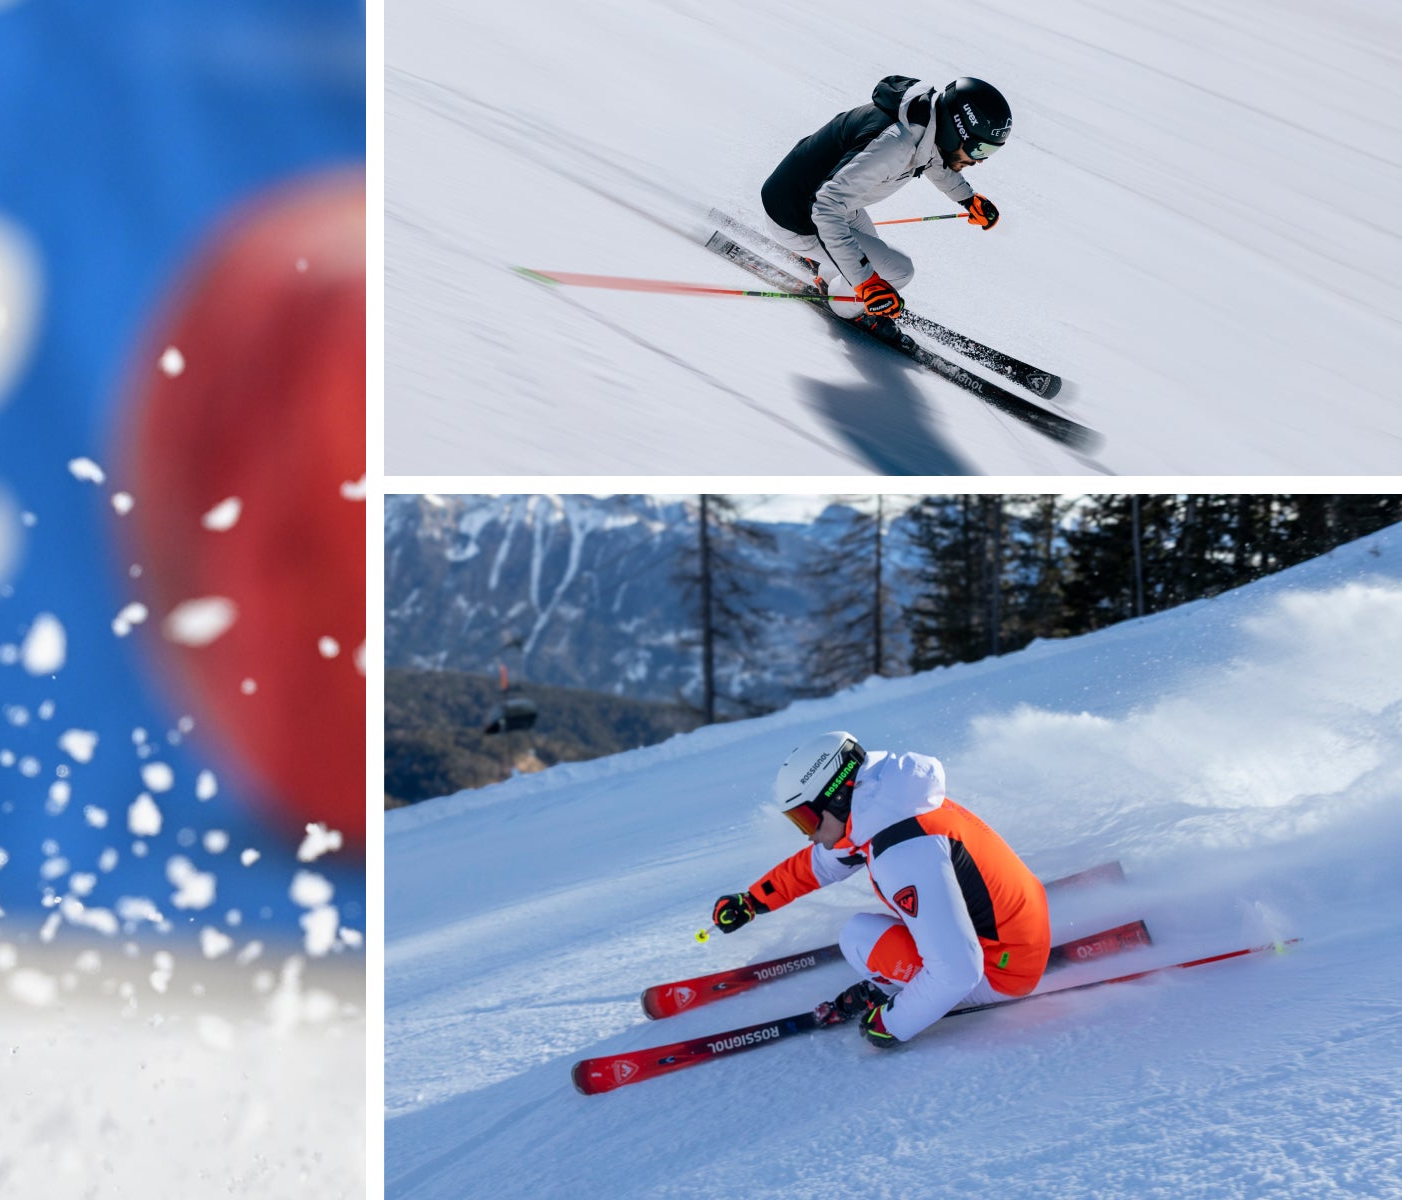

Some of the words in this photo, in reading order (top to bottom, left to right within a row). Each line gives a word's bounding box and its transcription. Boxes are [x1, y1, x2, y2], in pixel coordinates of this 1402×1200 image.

[953, 114, 969, 140] uvex
[963, 103, 978, 126] uvex
[799, 752, 830, 785] ROSSIGNOL
[824, 760, 857, 798] ROSSIGNOL
[753, 955, 816, 980] ROSSIGNOL
[706, 1025, 780, 1053] ROSSIGNOL
